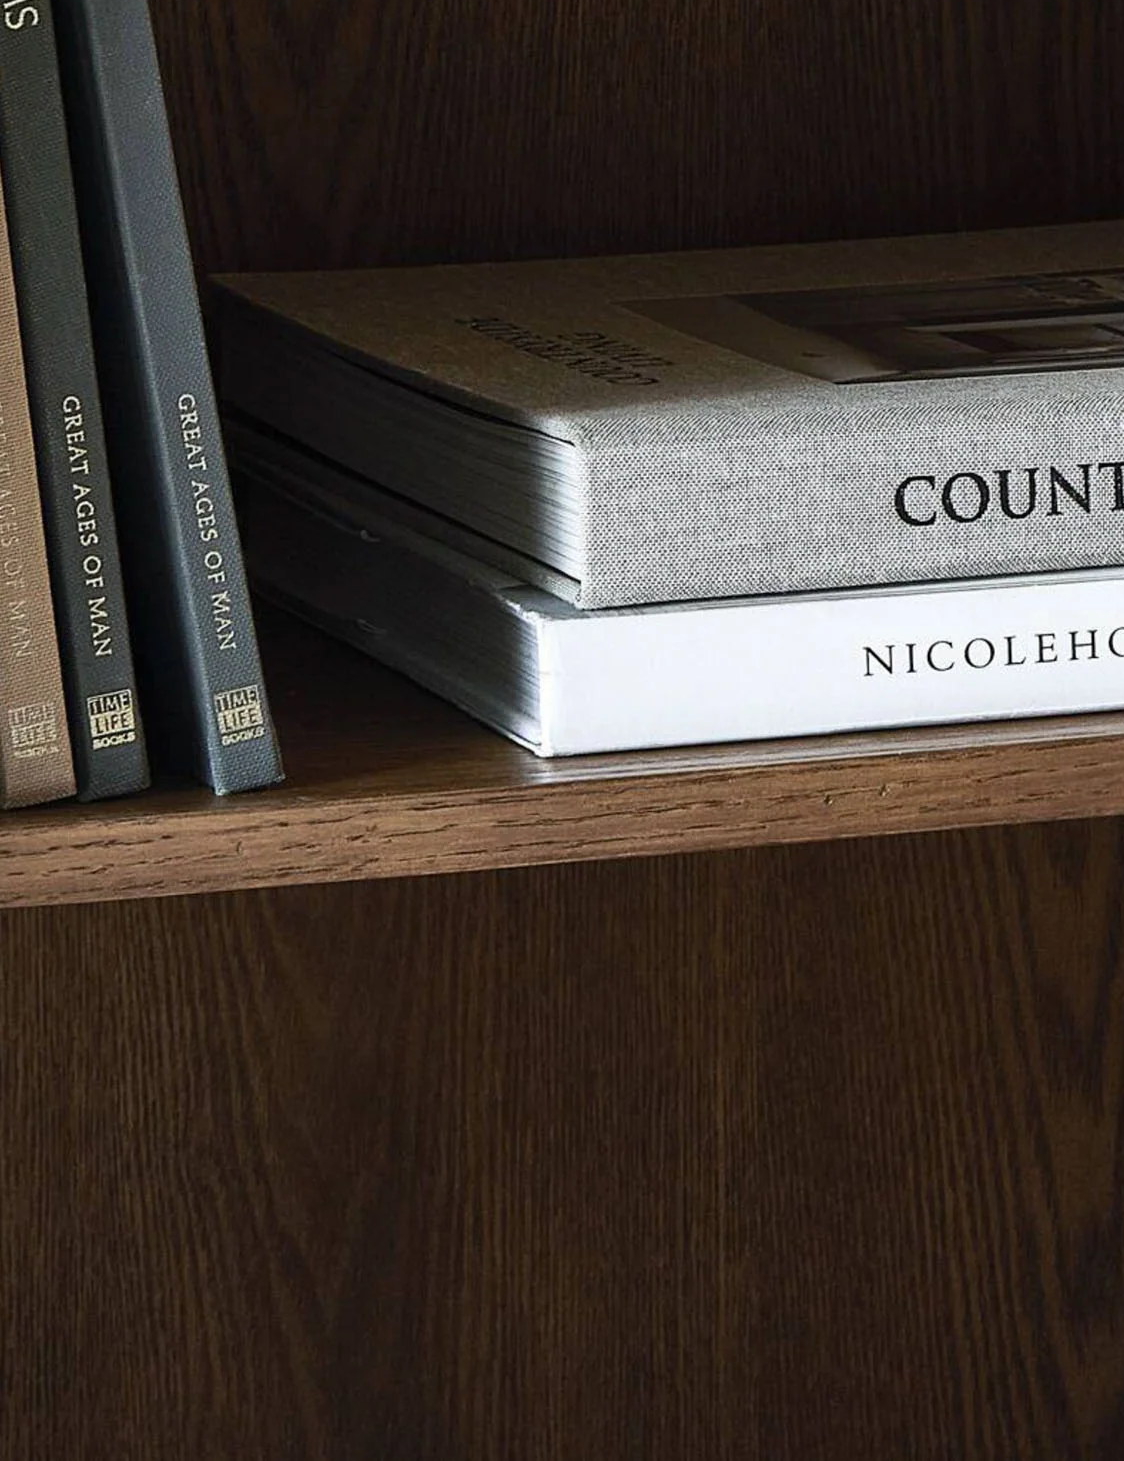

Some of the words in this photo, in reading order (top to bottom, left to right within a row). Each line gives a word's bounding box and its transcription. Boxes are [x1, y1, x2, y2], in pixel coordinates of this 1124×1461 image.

[62, 394, 90, 476] GREAT
[178, 393, 207, 473] GREAT
[73, 483, 99, 547] AGES
[192, 478, 219, 542] AGES
[82, 553, 106, 589] OF
[203, 551, 226, 584] OF
[88, 595, 113, 657] MAN
[210, 590, 237, 651] MAN
[90, 693, 129, 715] TIME
[93, 712, 131, 736] LIFE
[215, 689, 257, 712] TIME
[220, 706, 262, 733] LIFE
